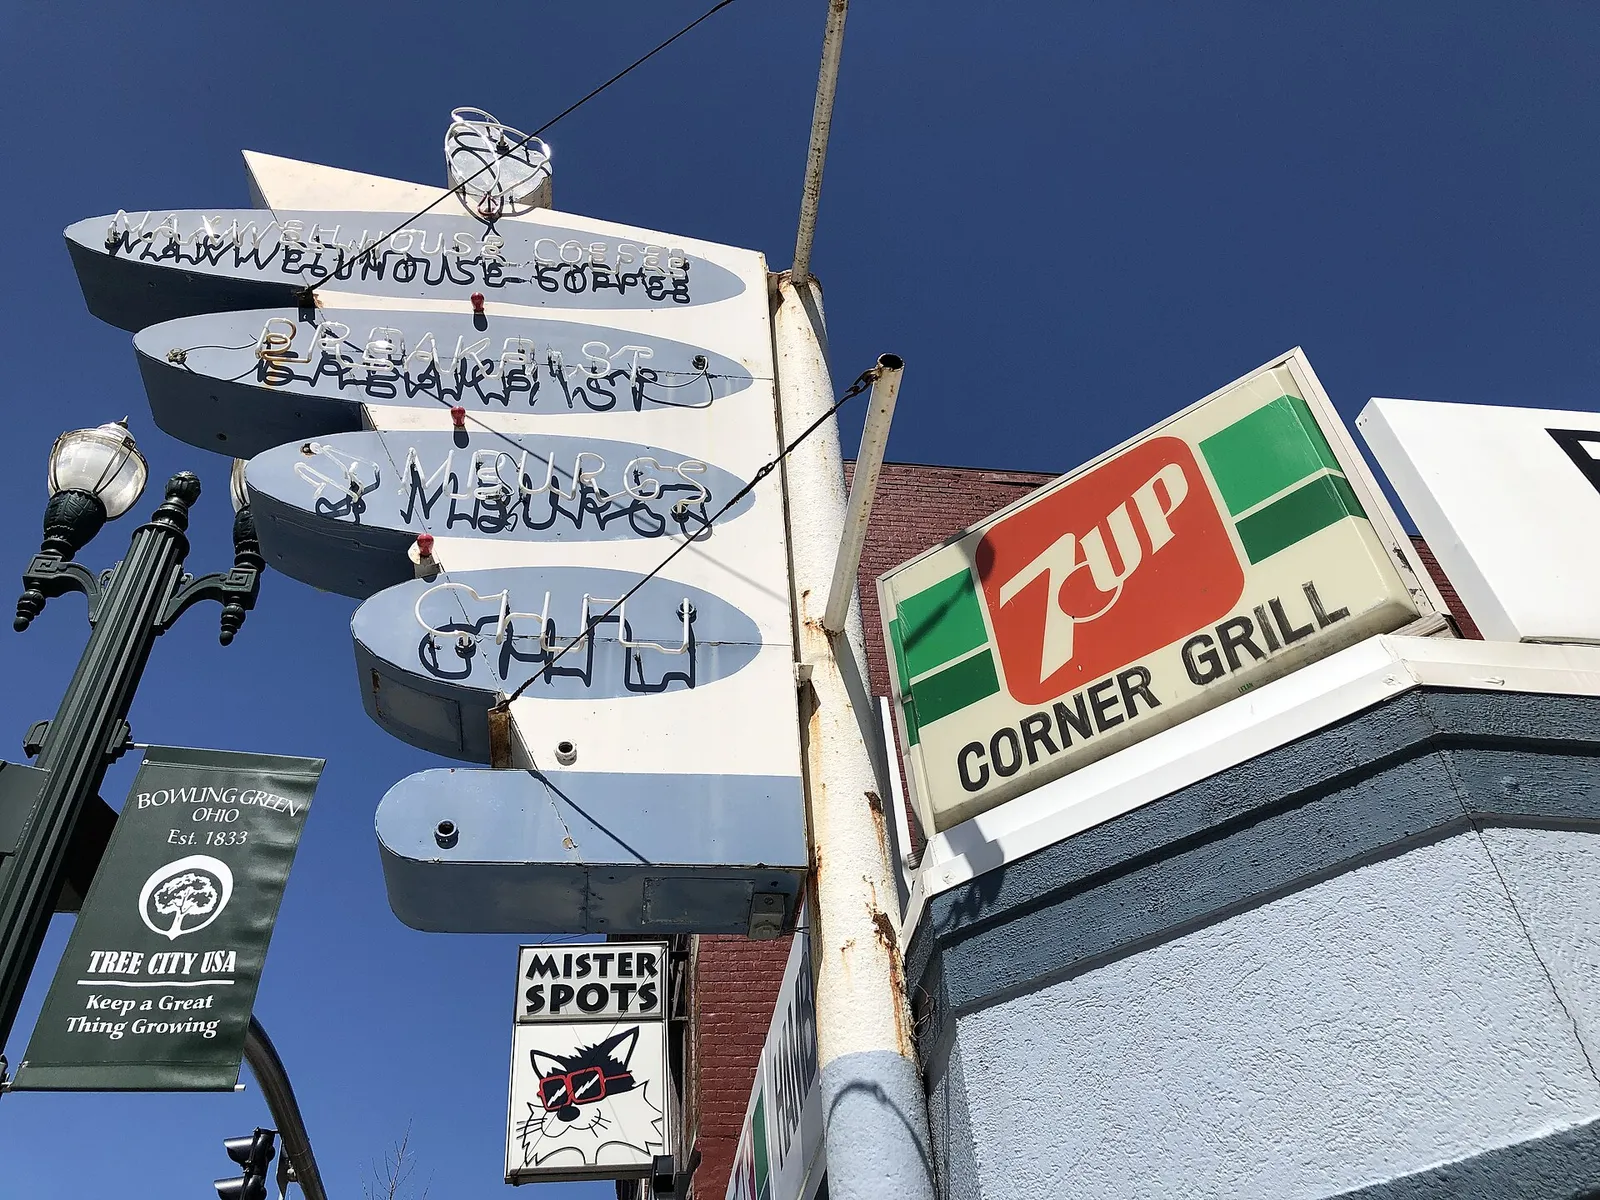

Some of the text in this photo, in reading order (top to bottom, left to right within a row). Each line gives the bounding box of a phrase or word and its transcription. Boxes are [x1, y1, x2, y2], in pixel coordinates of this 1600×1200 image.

[533, 238, 687, 280] COFFEE
[956, 580, 1350, 792] CORNER GRILL
[137, 786, 303, 818] BOWLING GREEN
[192, 807, 240, 823] OHIO
[167, 829, 248, 846] Est. 1833
[86, 950, 237, 975] TREE CITY USA
[525, 952, 659, 980] MISTER
[86, 994, 214, 1017] Keep a Great
[525, 982, 659, 1015] SPOTS
[66, 1015, 221, 1040] Thing Growing
[773, 951, 817, 1172] HAMB
